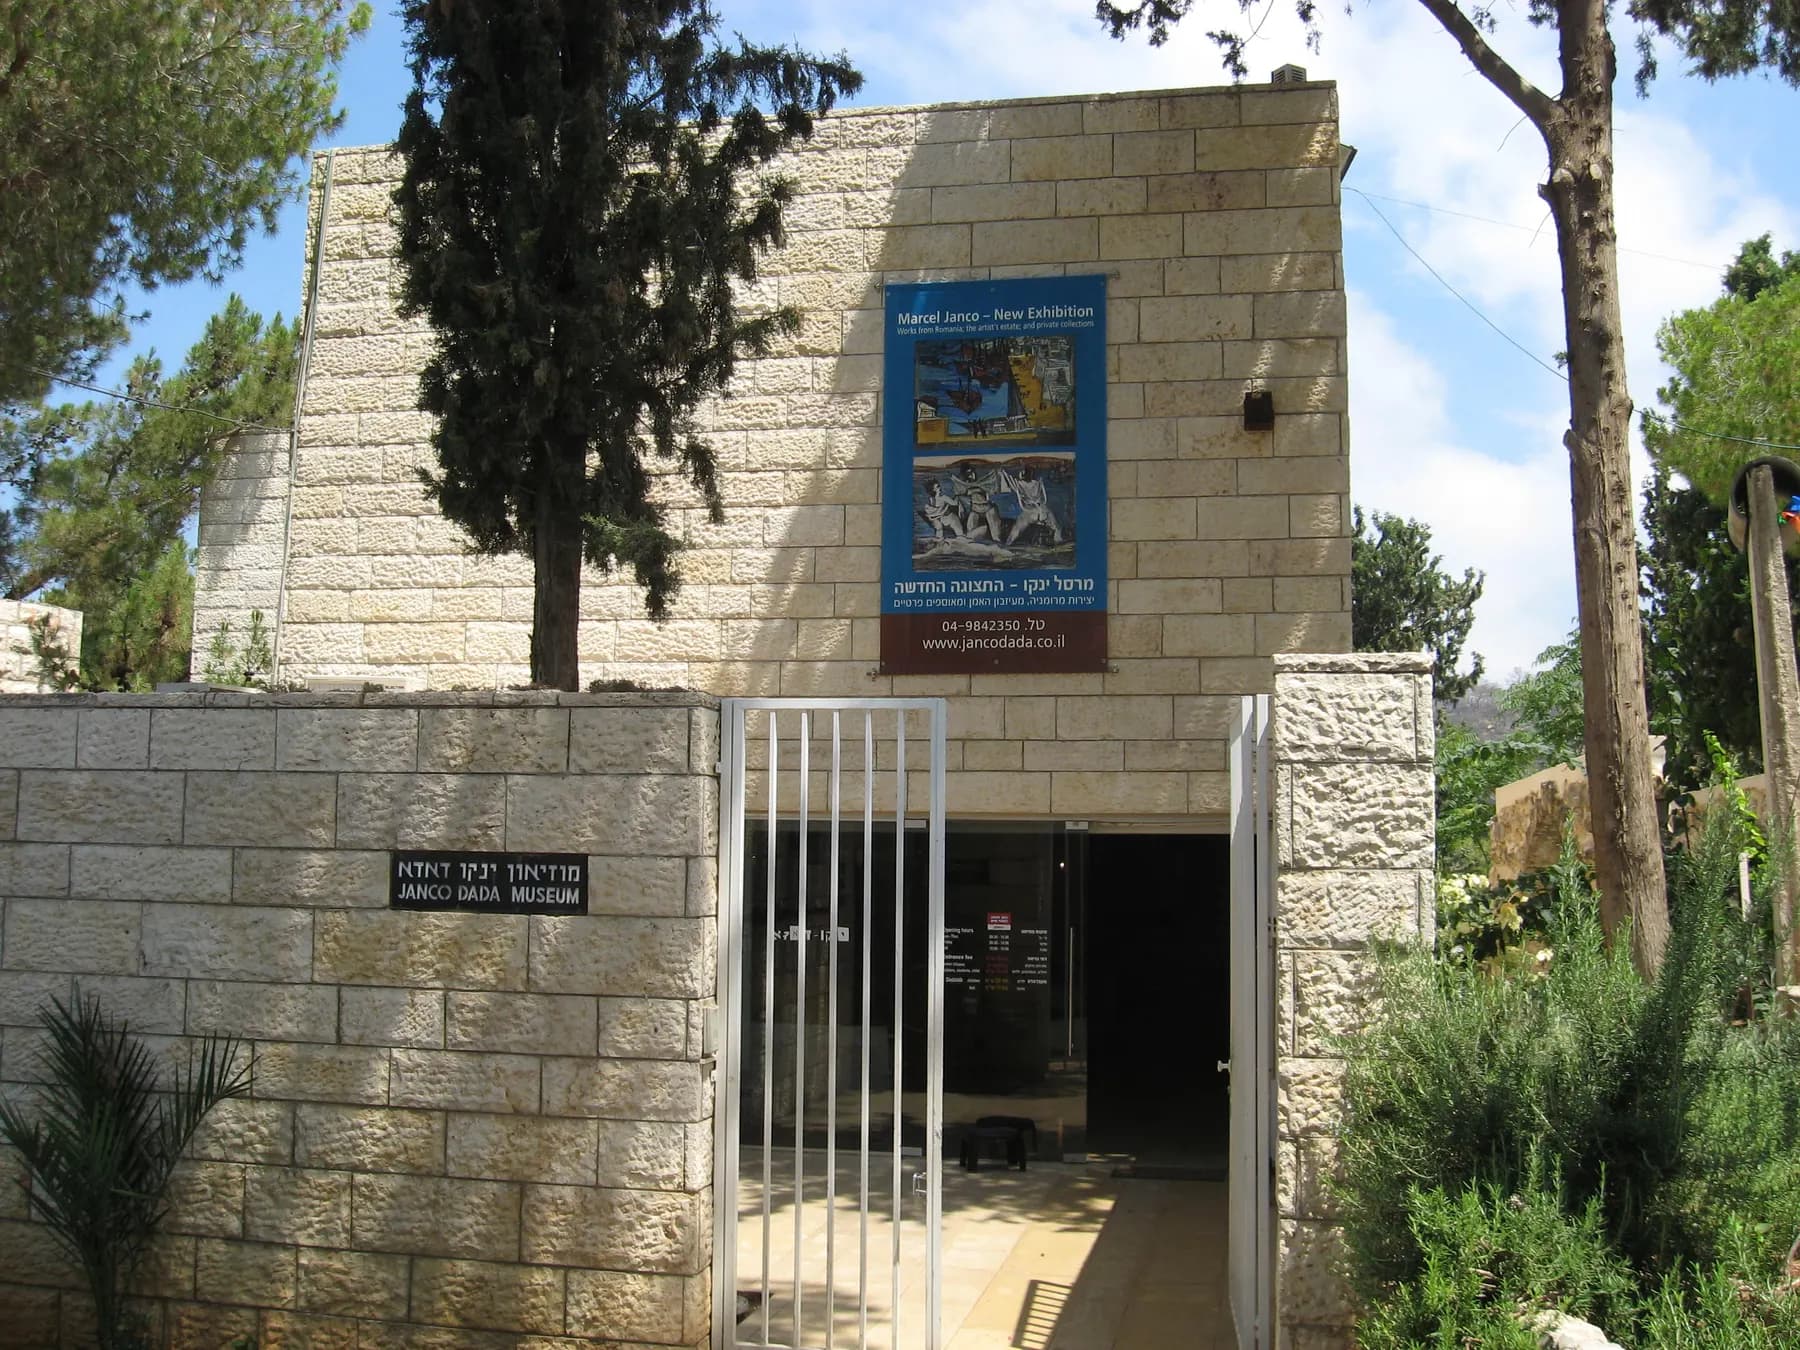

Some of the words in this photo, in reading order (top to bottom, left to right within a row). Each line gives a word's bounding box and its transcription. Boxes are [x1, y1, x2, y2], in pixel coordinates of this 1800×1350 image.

[898, 310, 940, 325] Marcel
[943, 311, 980, 323] Janco
[994, 308, 1023, 320] New
[1028, 305, 1094, 319] Exhibition
[897, 327, 917, 335] Works
[918, 326, 934, 334] from
[1036, 321, 1059, 330] private
[894, 581, 946, 594] החדשה
[951, 580, 1002, 593] התצוגה
[1024, 579, 1050, 595] ינקו
[1054, 575, 1094, 591] מרסל
[893, 599, 923, 608] פרטיים
[926, 598, 966, 607] ומאוספים
[969, 598, 991, 608] האמן
[994, 597, 1024, 608] מעיזבון
[1027, 596, 1065, 606] מרומניה,
[1068, 596, 1095, 605] יצירות
[942, 619, 1020, 632] 04-9842350
[1025, 617, 1046, 631] טל.
[922, 634, 1065, 652] www.jancodada.co.il
[398, 861, 451, 879] דאדא
[460, 862, 497, 881] ינקו
[507, 863, 580, 882] מוזיאון
[398, 883, 452, 901] JANCO
[458, 885, 500, 902] DADA
[511, 886, 580, 905] MUSEUM
